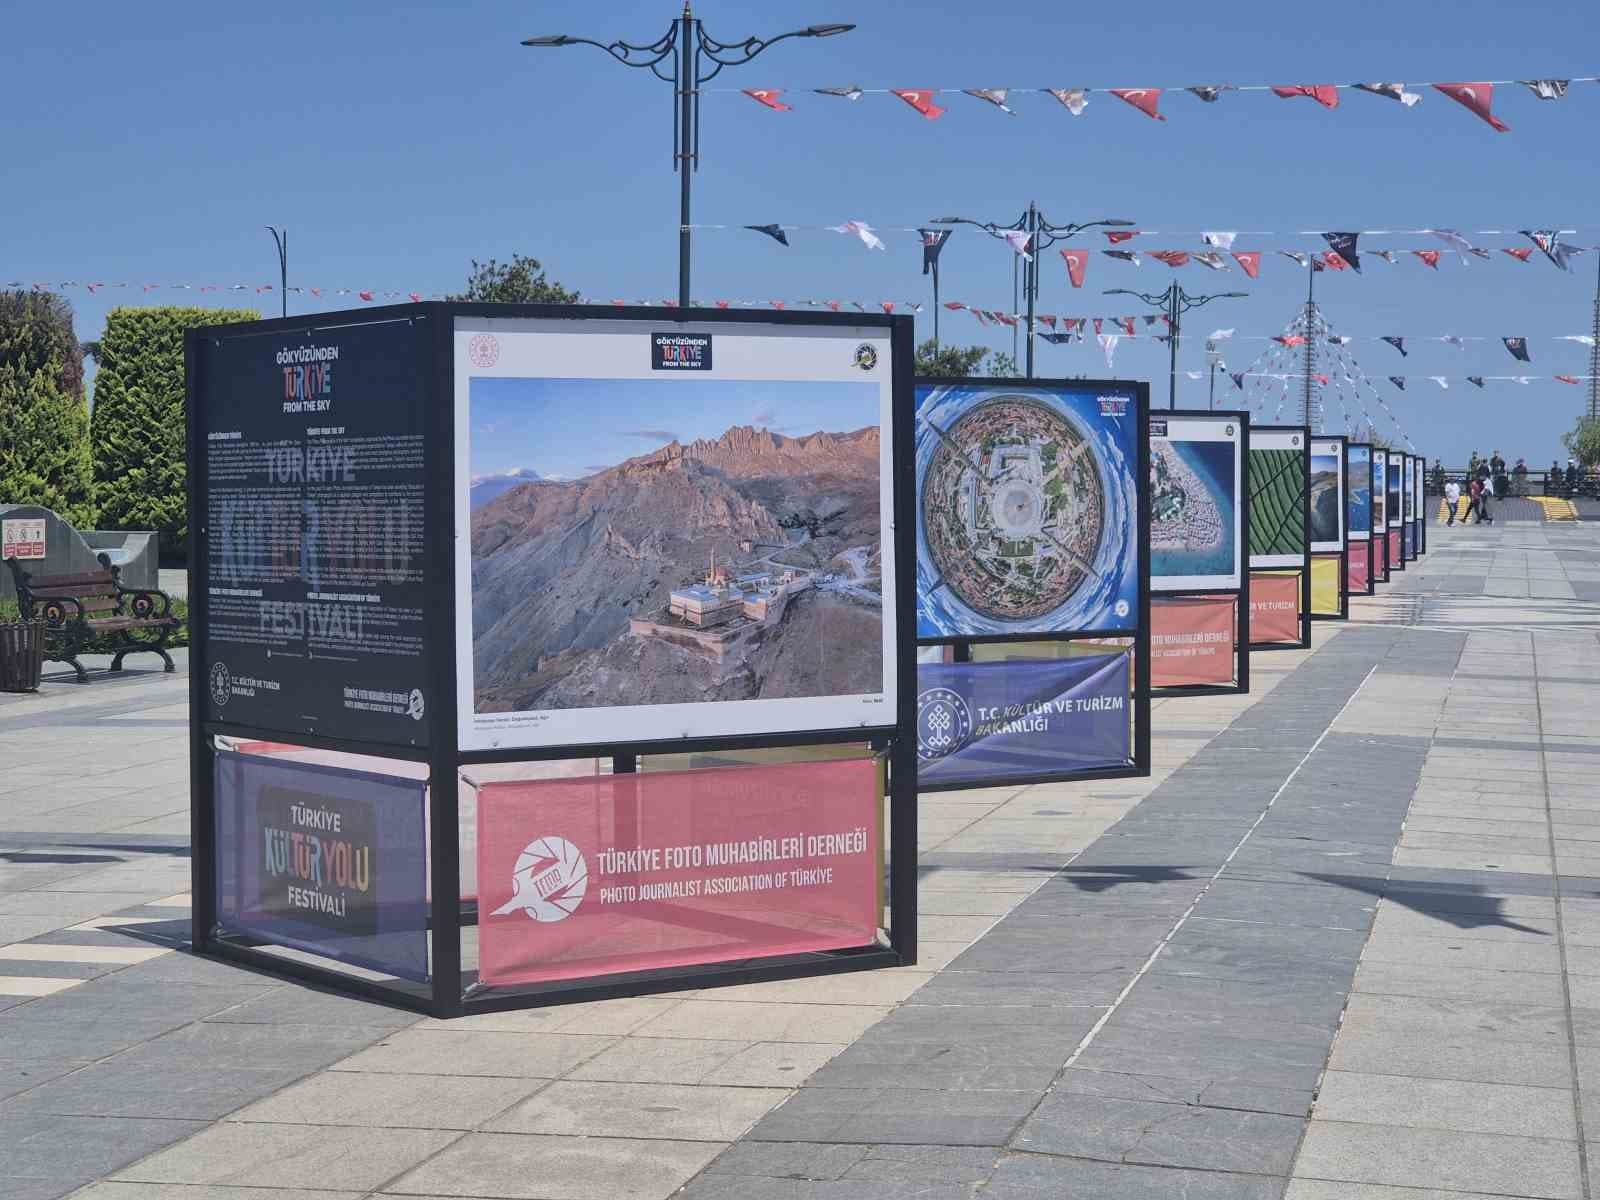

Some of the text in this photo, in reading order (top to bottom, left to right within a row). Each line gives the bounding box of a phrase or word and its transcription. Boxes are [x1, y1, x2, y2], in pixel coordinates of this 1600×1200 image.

[276, 344, 339, 365] GÖKYÜZÜNDEN
[283, 362, 331, 400] TÜRKİYE
[283, 400, 331, 413] FROM THE SKY
[1003, 700, 1053, 717] KÜLTÜR
[1055, 699, 1073, 713] VE
[1076, 695, 1123, 712] TURİZM
[975, 716, 1048, 736] BAKANLIĞI
[290, 801, 341, 832] TÜRKİYE
[265, 827, 369, 892] KÜLTÜR YOLU
[597, 826, 867, 875] TÜRKİYE FOTO MUHABİRLERİ DERNEĞİ
[600, 866, 833, 904] PHOTO JOURNALIST ASSOCIATION OF TÜRKİYE
[288, 886, 345, 917] FESTİVALİ
